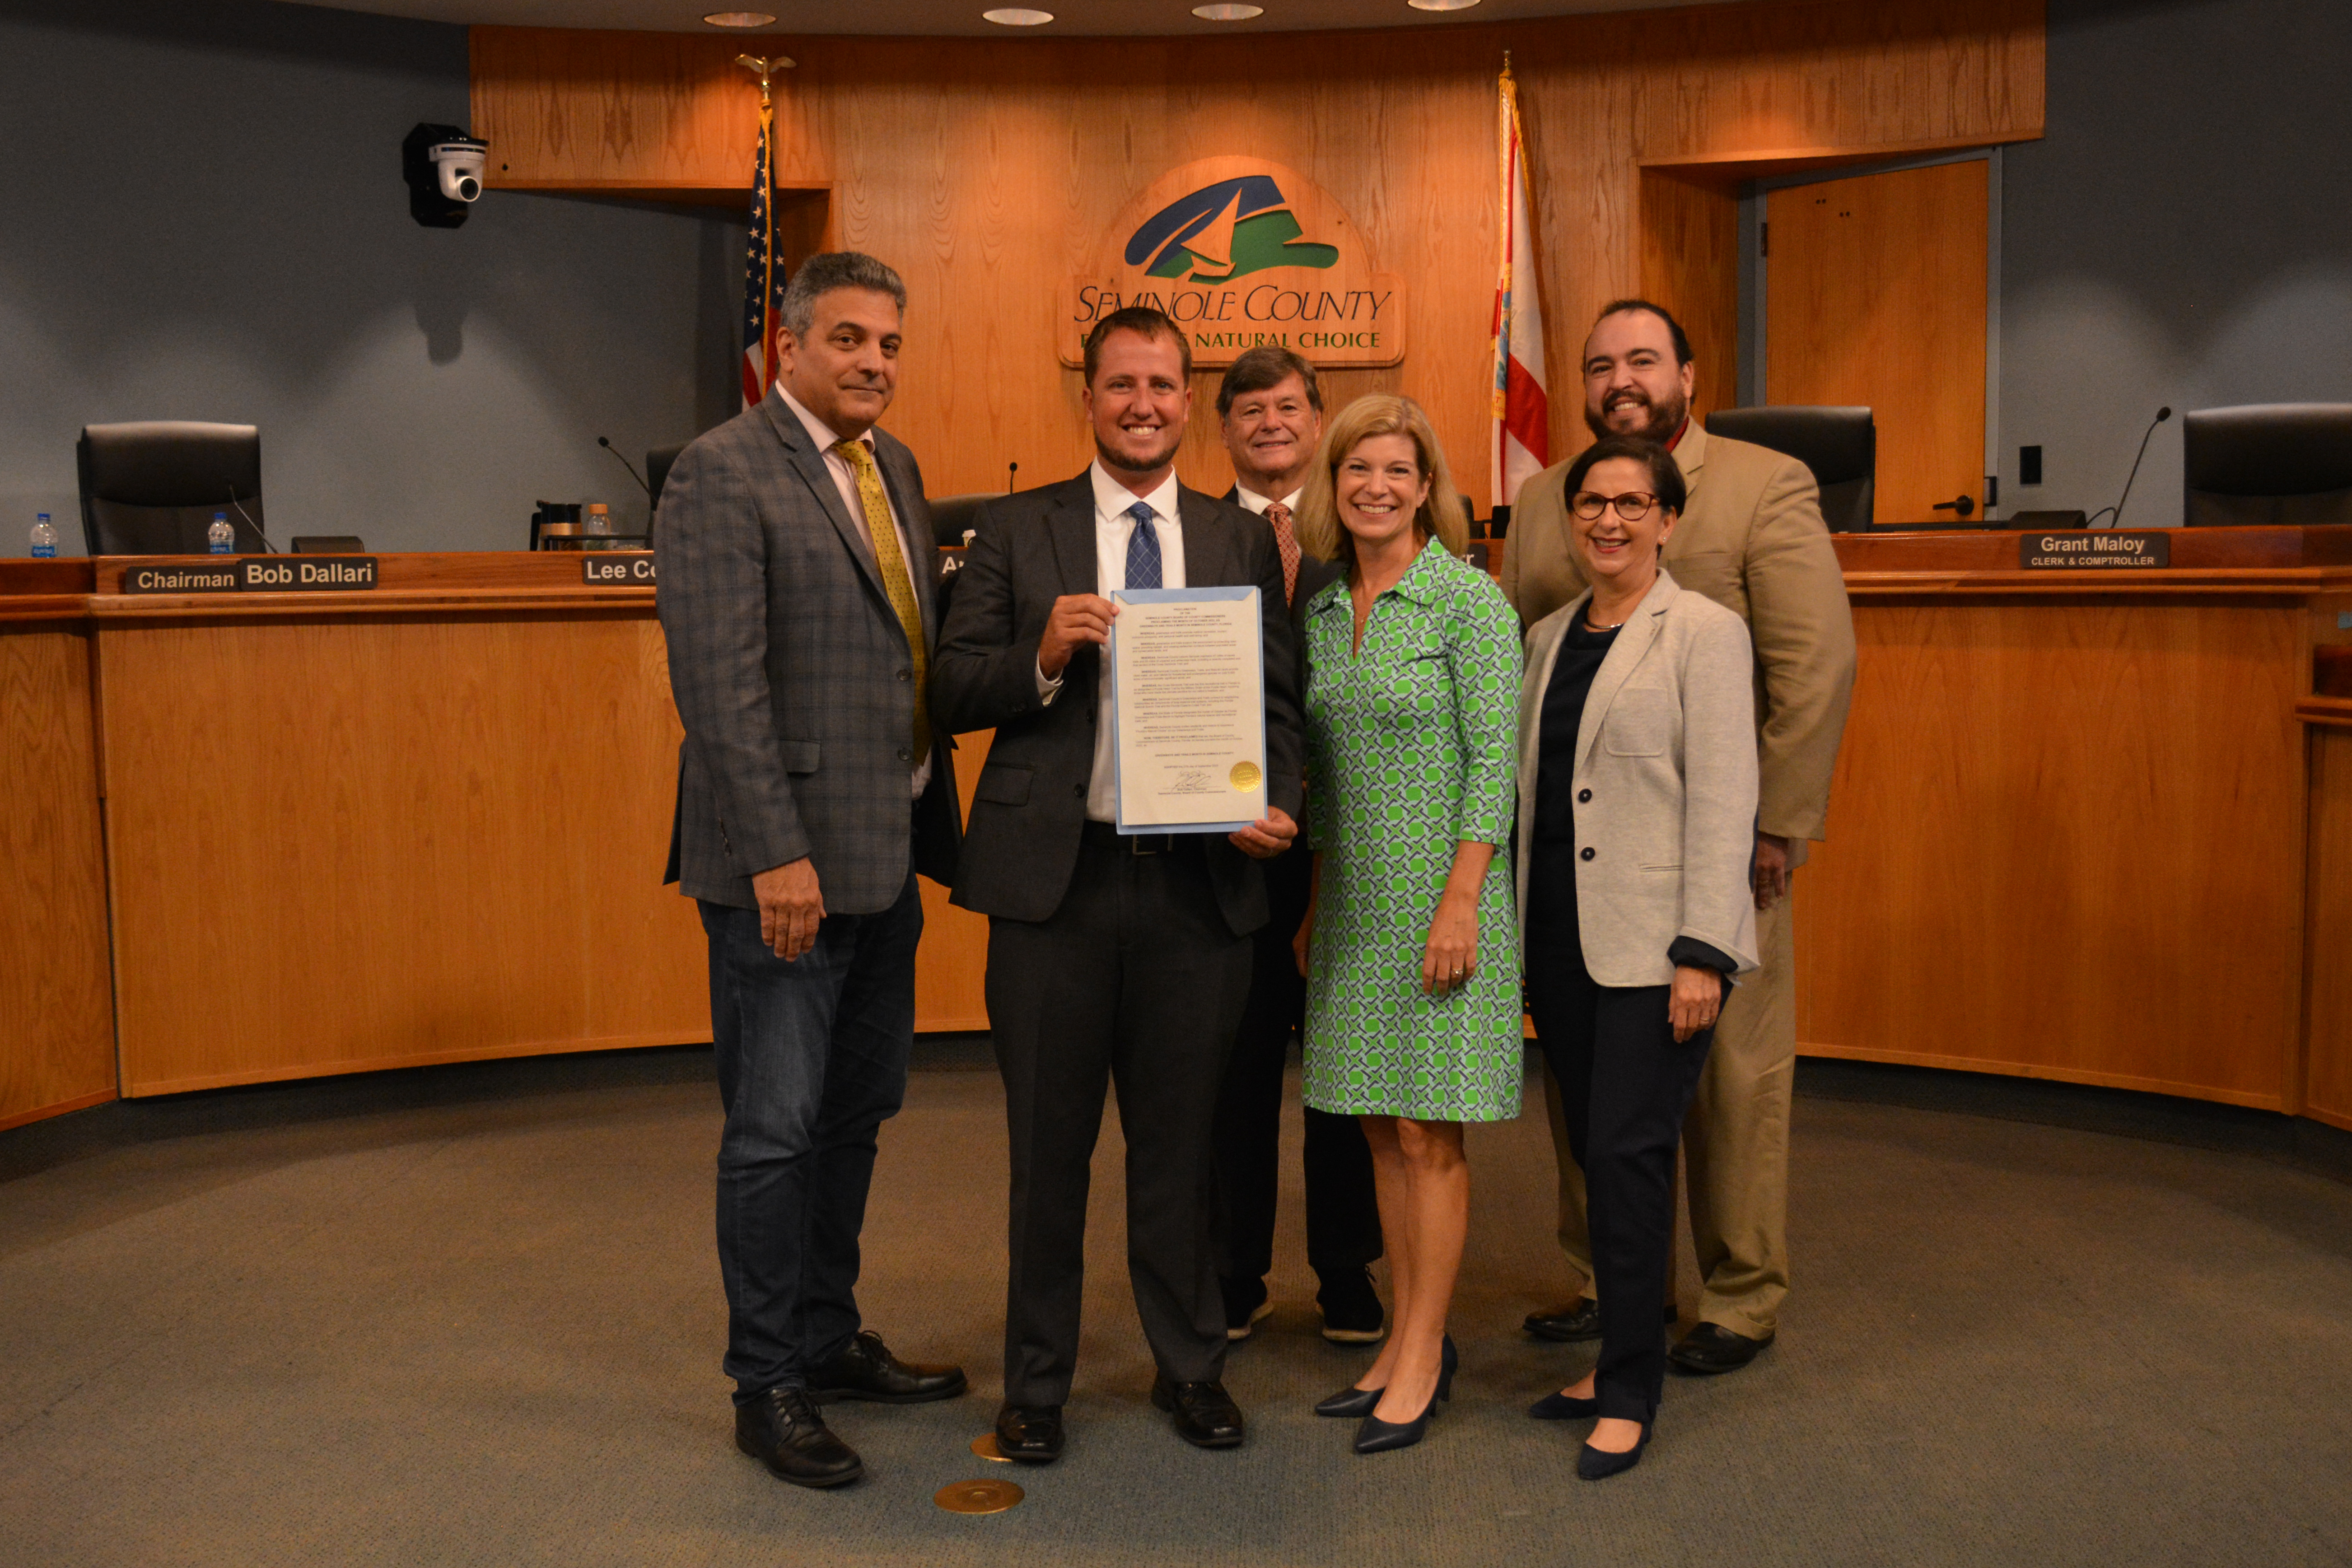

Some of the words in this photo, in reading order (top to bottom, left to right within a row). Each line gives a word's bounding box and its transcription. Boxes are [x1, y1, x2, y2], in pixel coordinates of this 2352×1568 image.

[1244, 285, 1392, 321] COUNTY
[1195, 332, 1292, 349] NATURAL
[1298, 331, 1381, 349] CHOICE
[2040, 537, 2088, 552] Grant
[2094, 537, 2145, 555] Maloy
[587, 561, 626, 579] Lee
[2031, 557, 2064, 566] CLERK
[2068, 557, 2076, 565] &
[2078, 556, 2155, 565] COMPTROLLER
[138, 570, 235, 589] Chairman
[247, 565, 293, 584] Bob
[301, 563, 372, 583] Dallari
